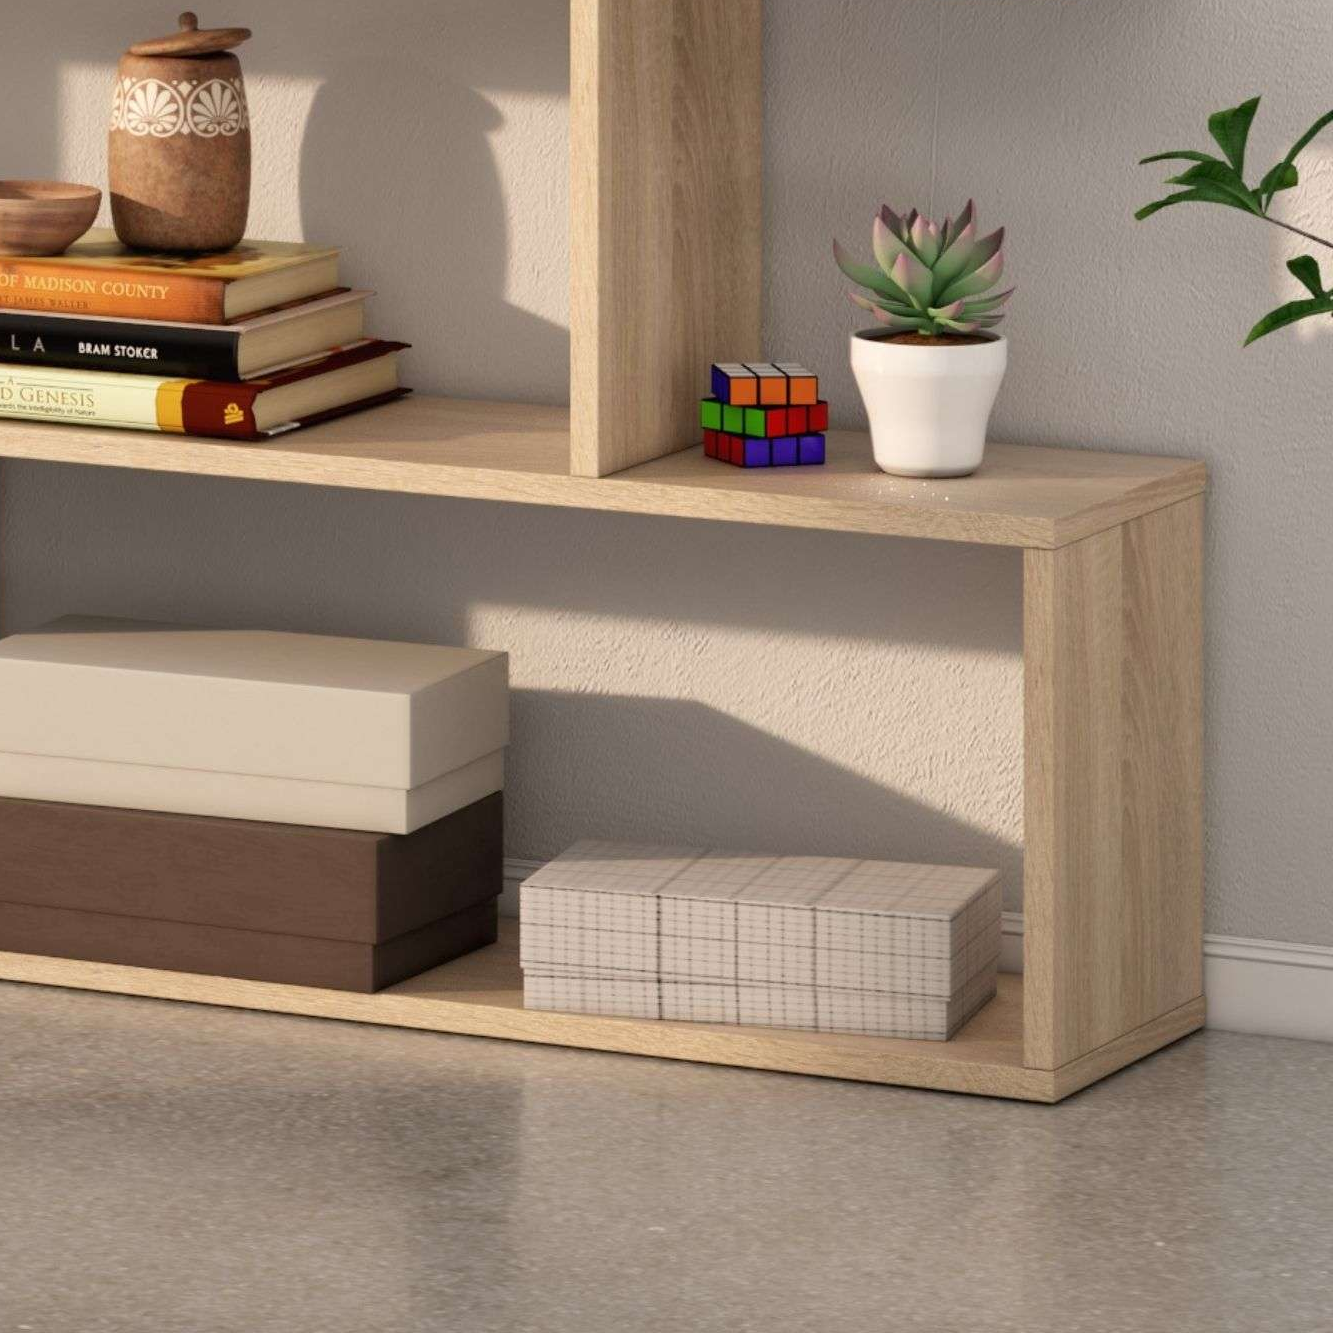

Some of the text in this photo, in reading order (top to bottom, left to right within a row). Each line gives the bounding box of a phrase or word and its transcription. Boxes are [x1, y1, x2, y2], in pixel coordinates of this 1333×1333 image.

[23, 275, 97, 294] MADISON
[102, 281, 170, 301] COUNTY
[13, 295, 44, 307] JAMES
[47, 299, 92, 311] WALLER
[78, 341, 112, 357] BRAM
[114, 344, 158, 360] STOKER
[6, 376, 14, 386] A
[20, 386, 95, 408] GENESIS
